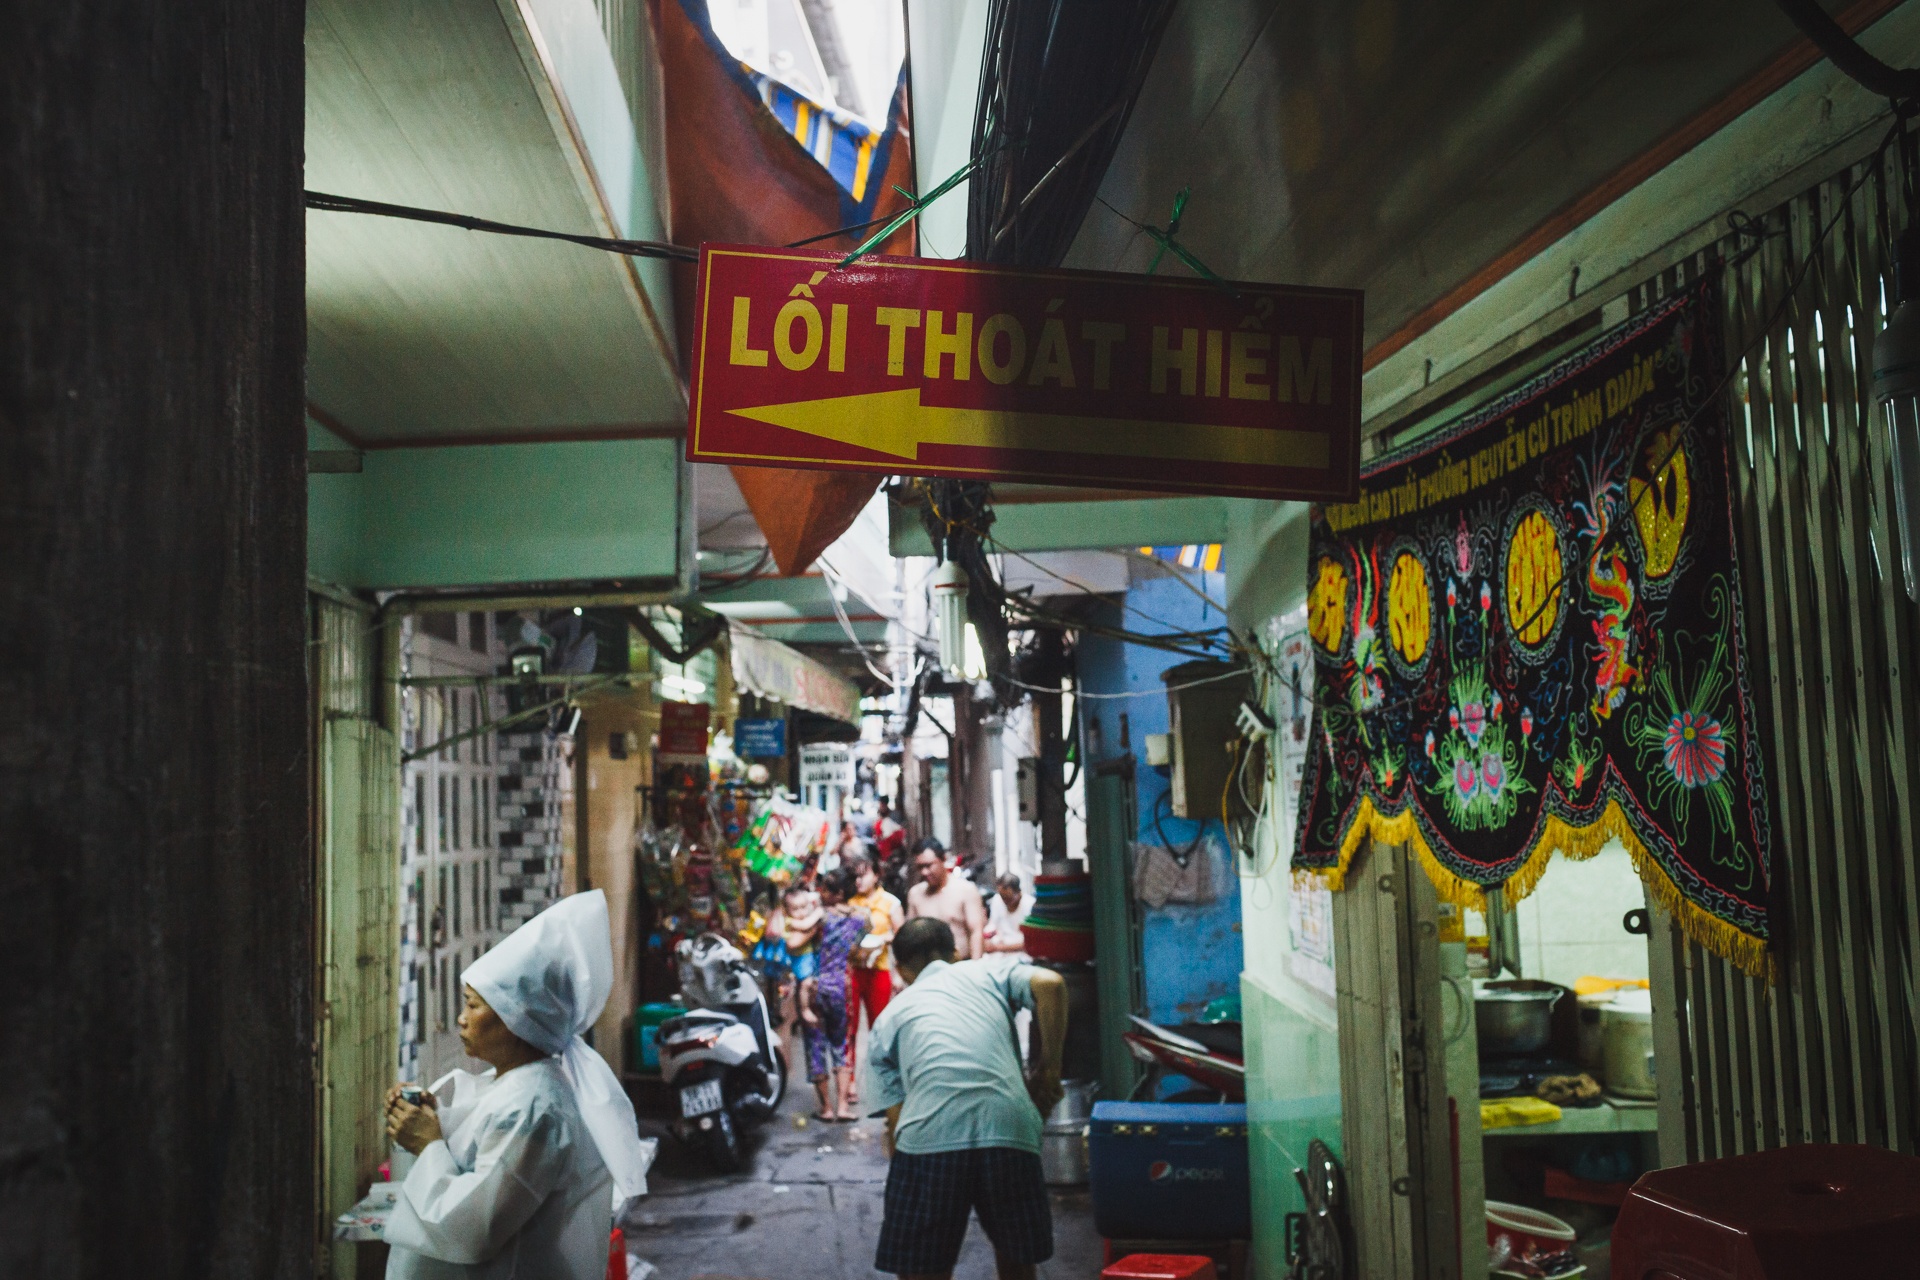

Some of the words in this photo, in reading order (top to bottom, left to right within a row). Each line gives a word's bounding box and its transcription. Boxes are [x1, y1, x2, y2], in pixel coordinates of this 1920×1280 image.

[729, 271, 849, 373] LỐI
[876, 299, 1126, 391] THOÁT
[1150, 299, 1334, 403] HIỂM
[1470, 416, 1527, 491] NGUYỄN
